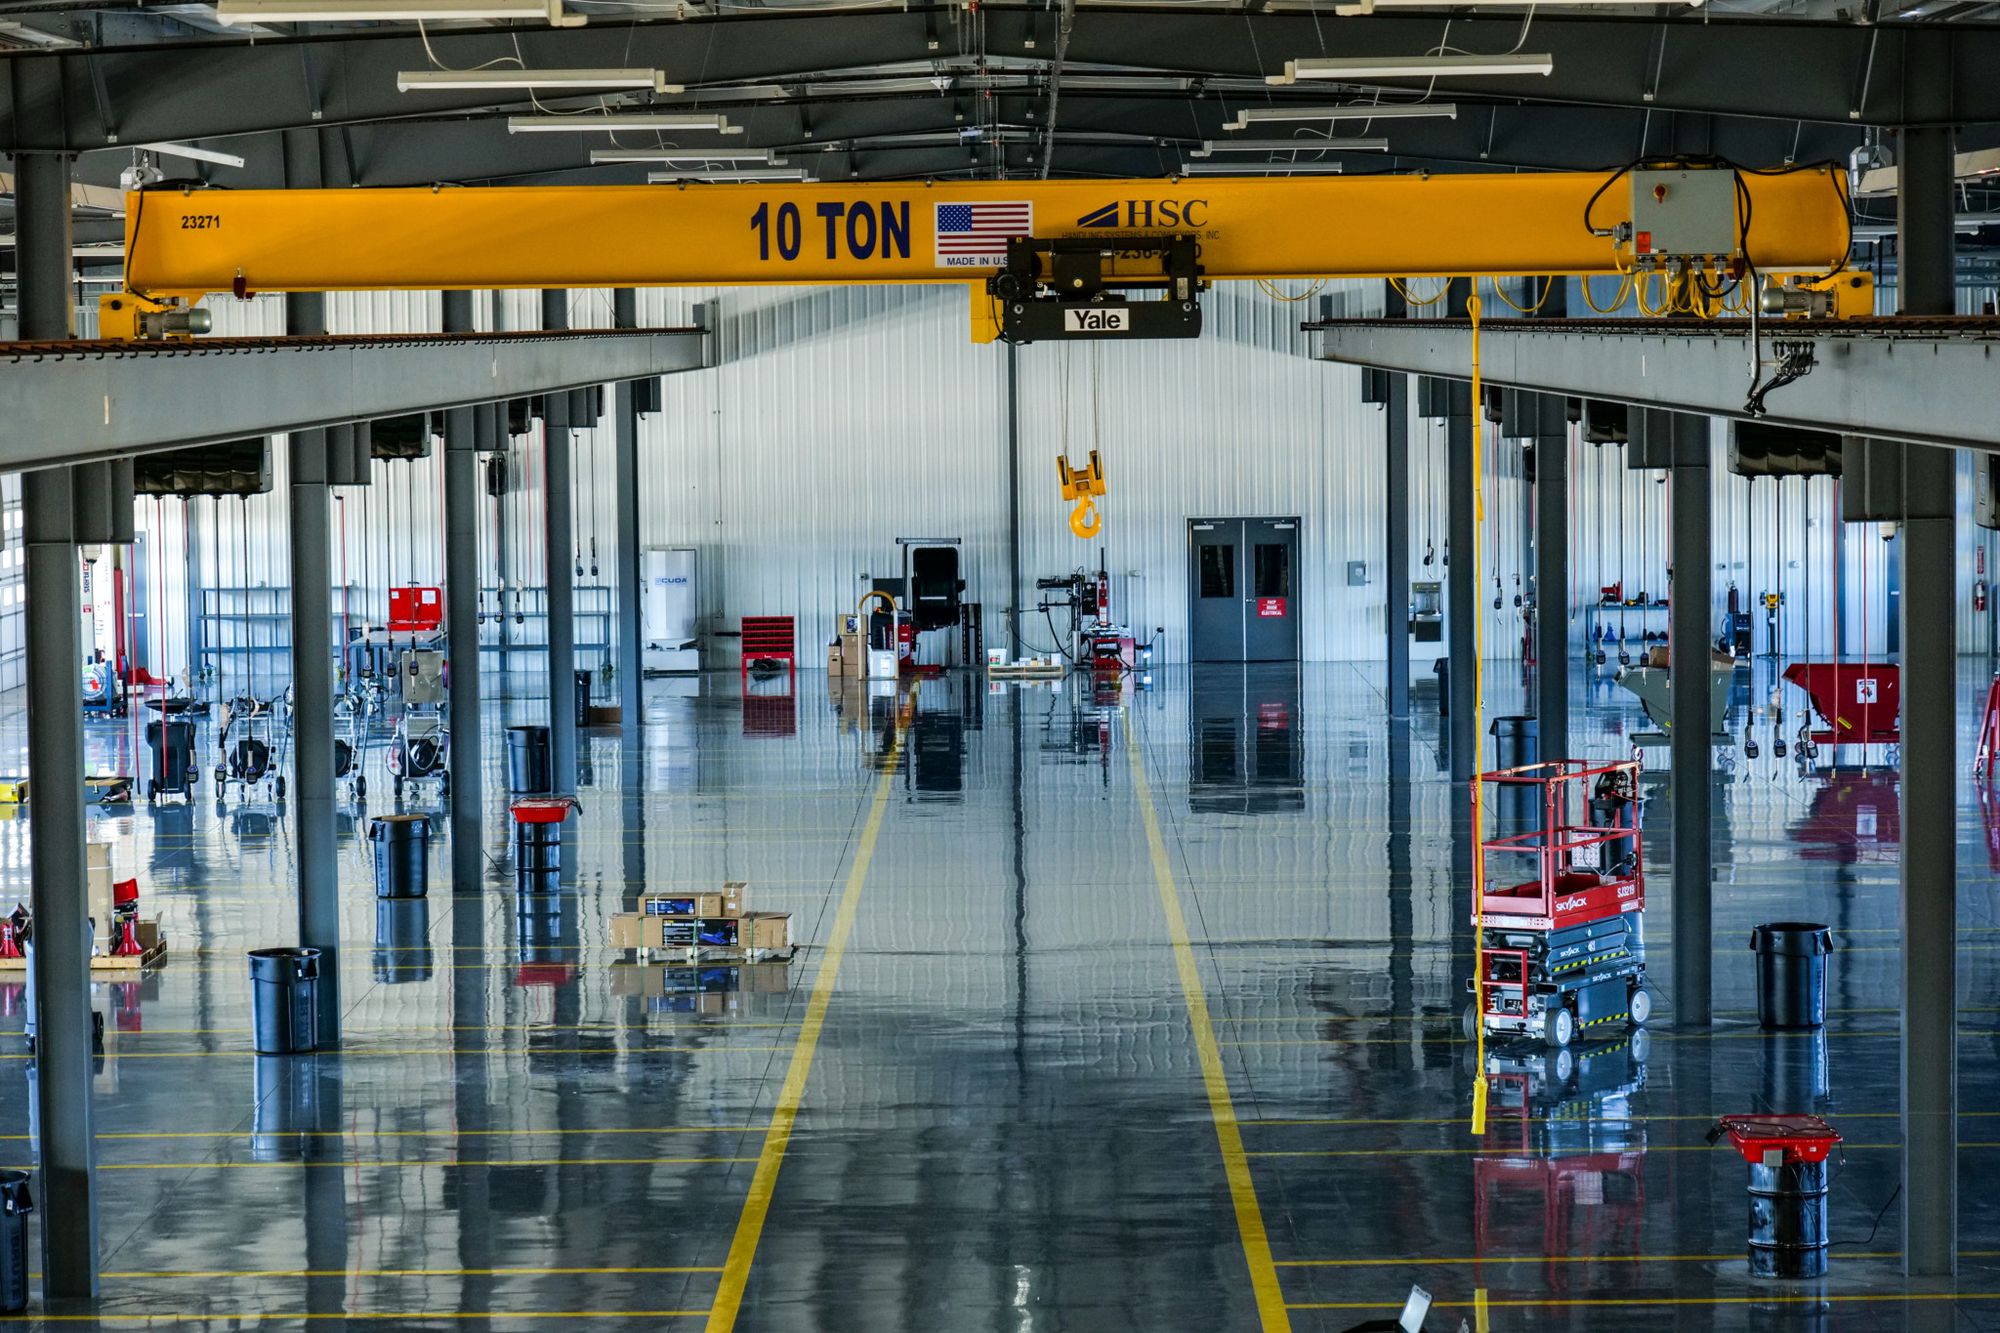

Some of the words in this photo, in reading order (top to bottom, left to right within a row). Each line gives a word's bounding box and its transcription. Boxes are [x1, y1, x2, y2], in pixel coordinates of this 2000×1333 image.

[1125, 199, 1208, 228] HSC
[181, 215, 220, 229] 23271
[750, 202, 801, 261] 10
[816, 200, 910, 260] TON
[946, 257, 975, 266] MADE
[979, 256, 989, 265] IN
[1073, 310, 1121, 330] Yale
[1617, 884, 1635, 898] SJ3219
[1555, 896, 1587, 912] SKYJACK
